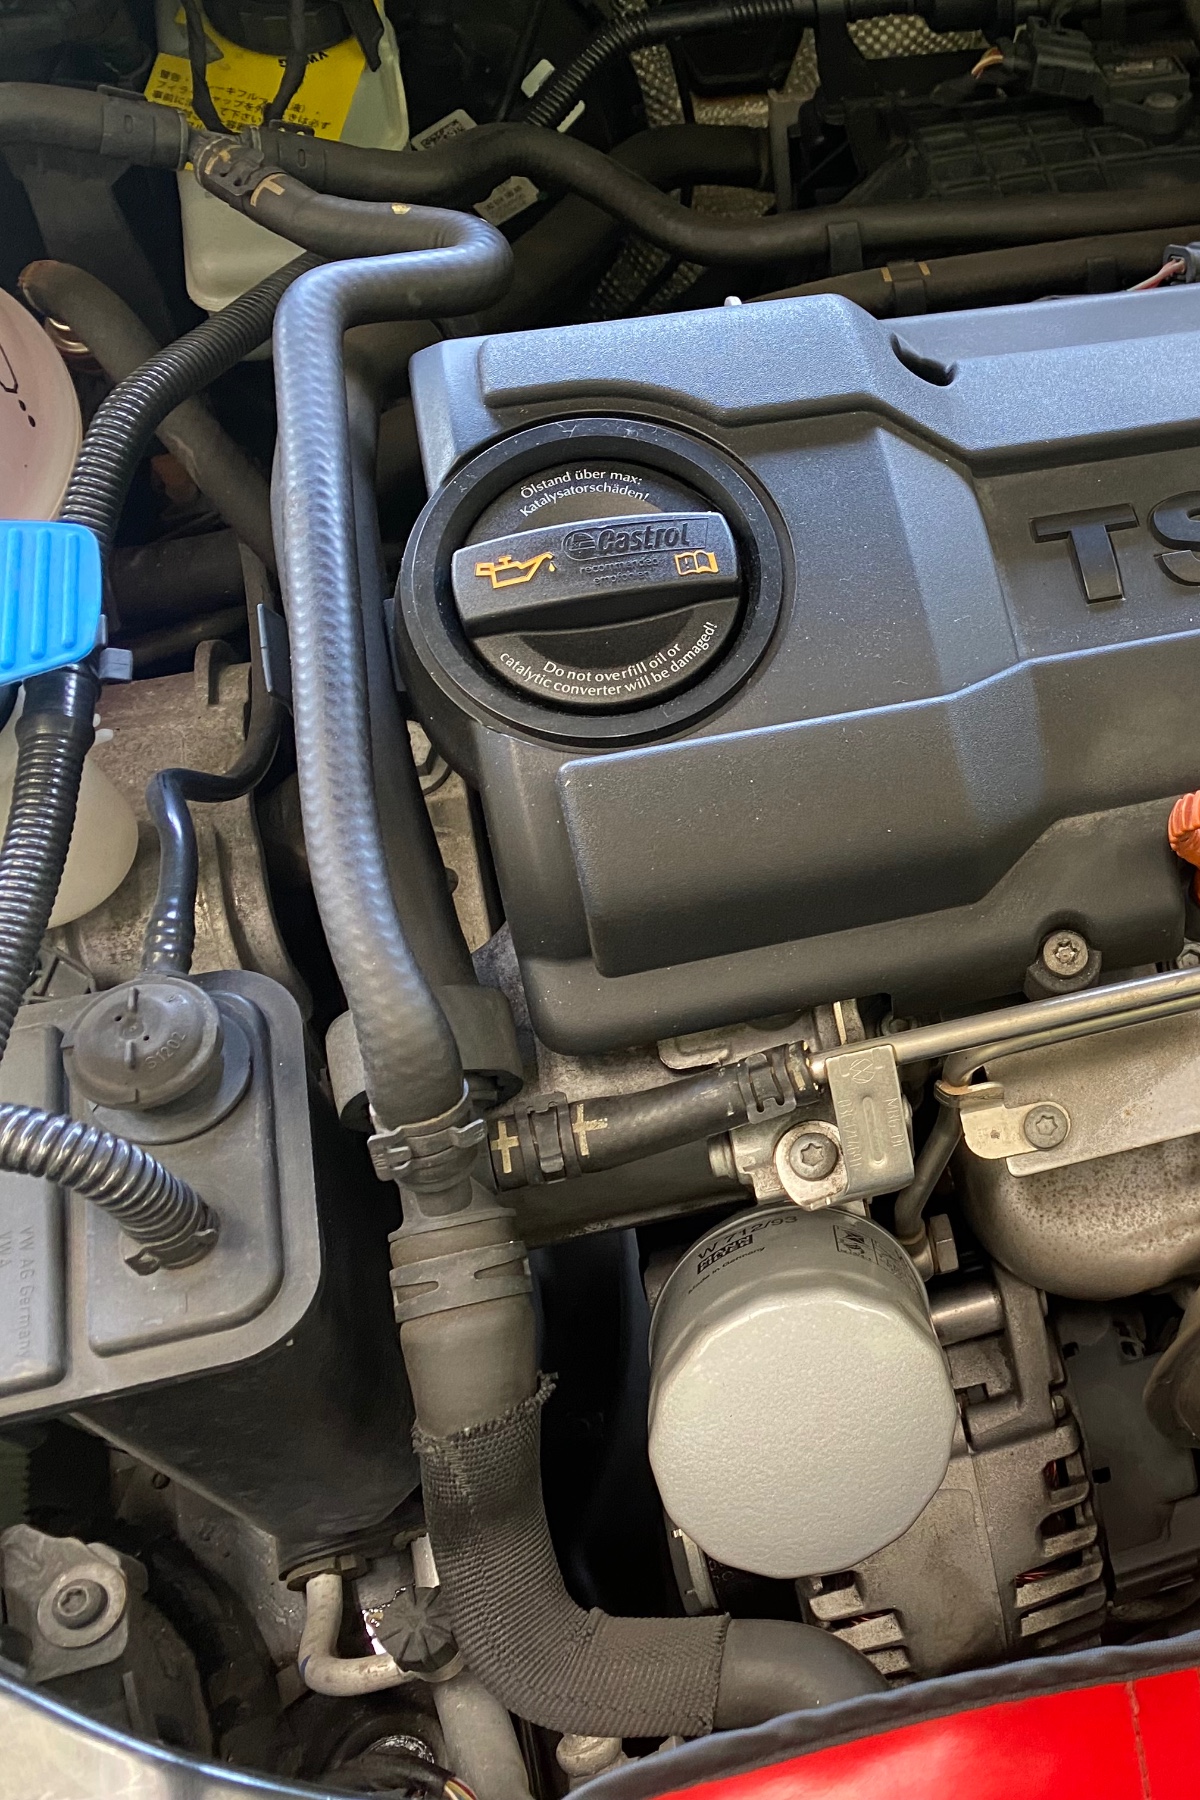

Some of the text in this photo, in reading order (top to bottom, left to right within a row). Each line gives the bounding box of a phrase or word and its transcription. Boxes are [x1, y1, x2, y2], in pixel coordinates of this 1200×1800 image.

[519, 482, 650, 517] Katalysatorschäden!
[520, 469, 643, 499] Ölstand über max:
[597, 522, 691, 553] Castrol
[580, 556, 661, 574] recommended
[593, 570, 650, 585] empfohlen
[500, 621, 718, 697] catalytic converter will be damaged!
[543, 643, 681, 682] Do not overfill oil or
[698, 1216, 798, 1259] W 712/93
[698, 1235, 753, 1274] MANN
[722, 1246, 766, 1268] Germany
[16, 1226, 35, 1358] VW AG Germany
